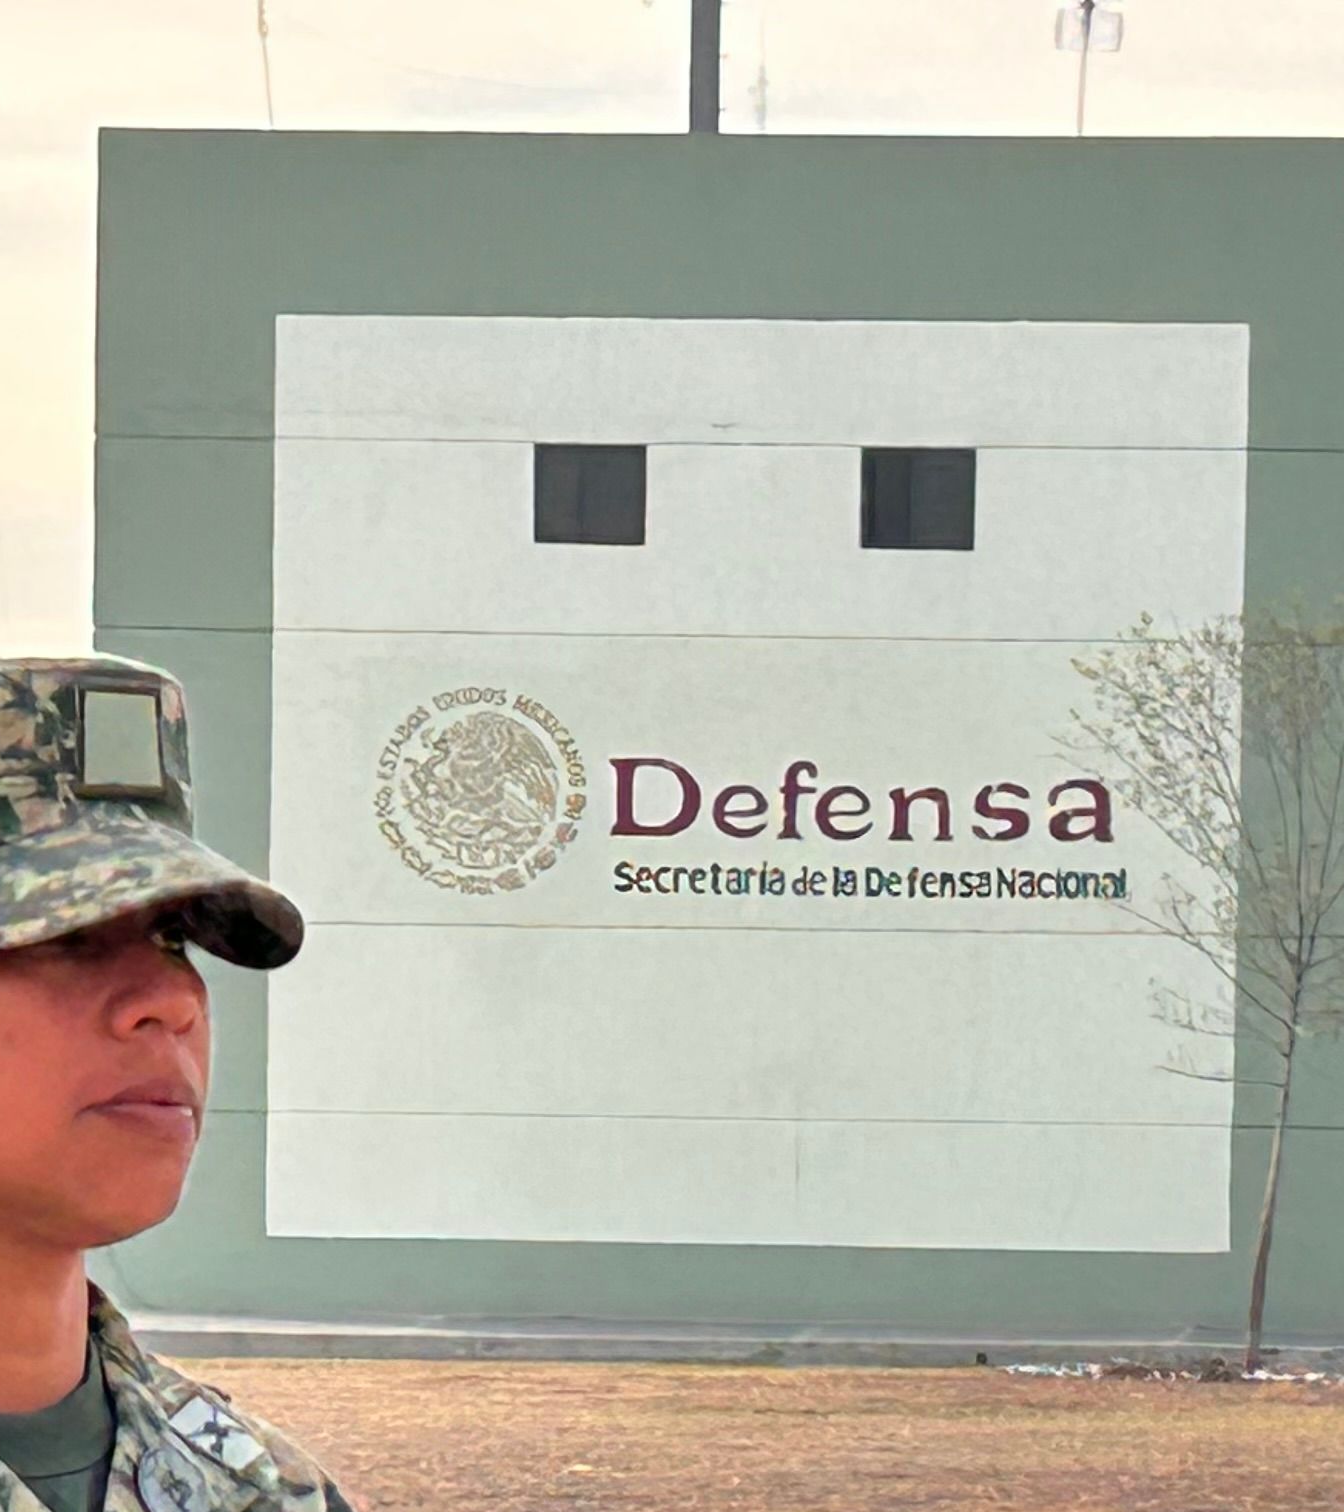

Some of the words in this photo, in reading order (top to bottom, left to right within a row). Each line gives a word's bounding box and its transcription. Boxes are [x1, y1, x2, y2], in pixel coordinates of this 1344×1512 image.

[609, 757, 1115, 843] Defensa
[791, 865, 827, 896] de
[832, 866, 858, 897] la
[864, 866, 992, 898] Defensa
[996, 866, 1127, 899] Nacional
